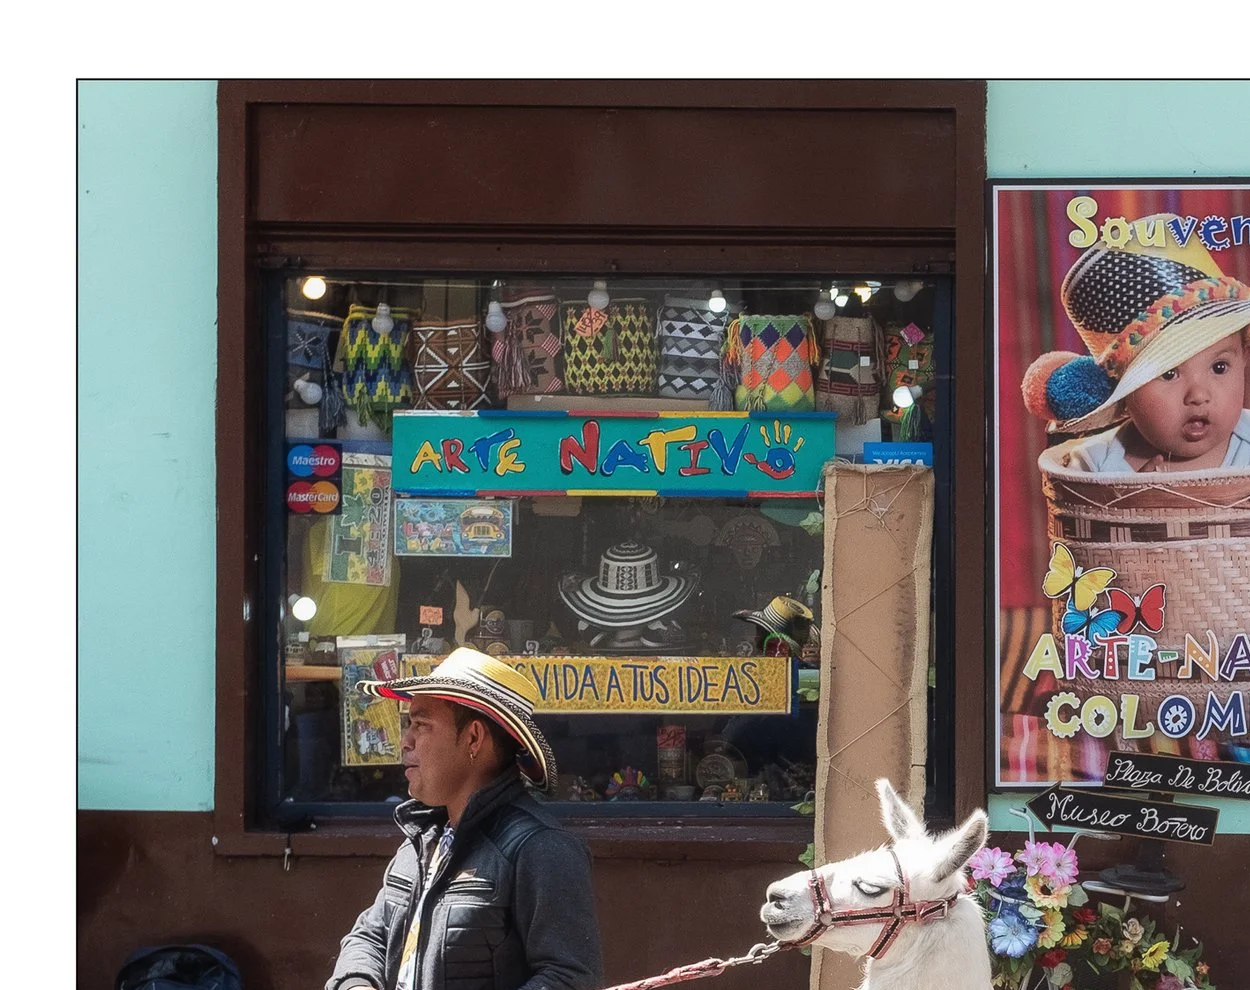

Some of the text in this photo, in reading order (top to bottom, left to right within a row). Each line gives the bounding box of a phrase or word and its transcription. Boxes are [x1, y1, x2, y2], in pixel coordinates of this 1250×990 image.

[292, 455, 336, 466] Maestro
[410, 428, 526, 476] ARTE
[287, 492, 338, 502] MasterCard
[531, 663, 599, 701] VIDA
[678, 661, 760, 705] IDEAS
[1106, 758, 1163, 788] Plaza
[1168, 764, 1196, 789] De
[1046, 792, 1132, 827] Museo
